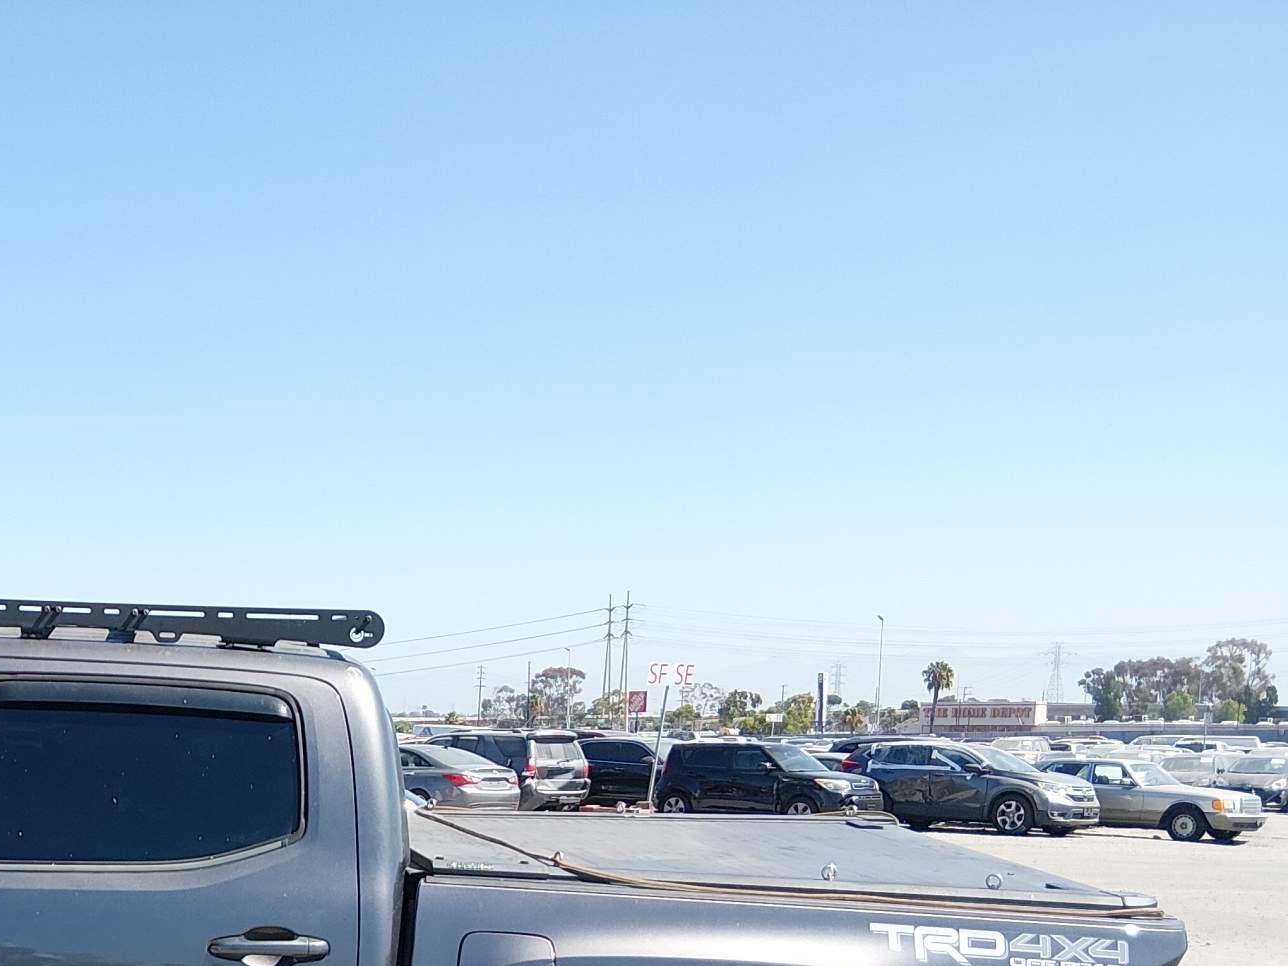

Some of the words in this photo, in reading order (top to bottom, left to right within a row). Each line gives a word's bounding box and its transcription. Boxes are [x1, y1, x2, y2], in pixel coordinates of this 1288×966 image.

[648, 663, 669, 684] SF
[674, 664, 695, 685] SE
[869, 922, 1009, 966] TRD
